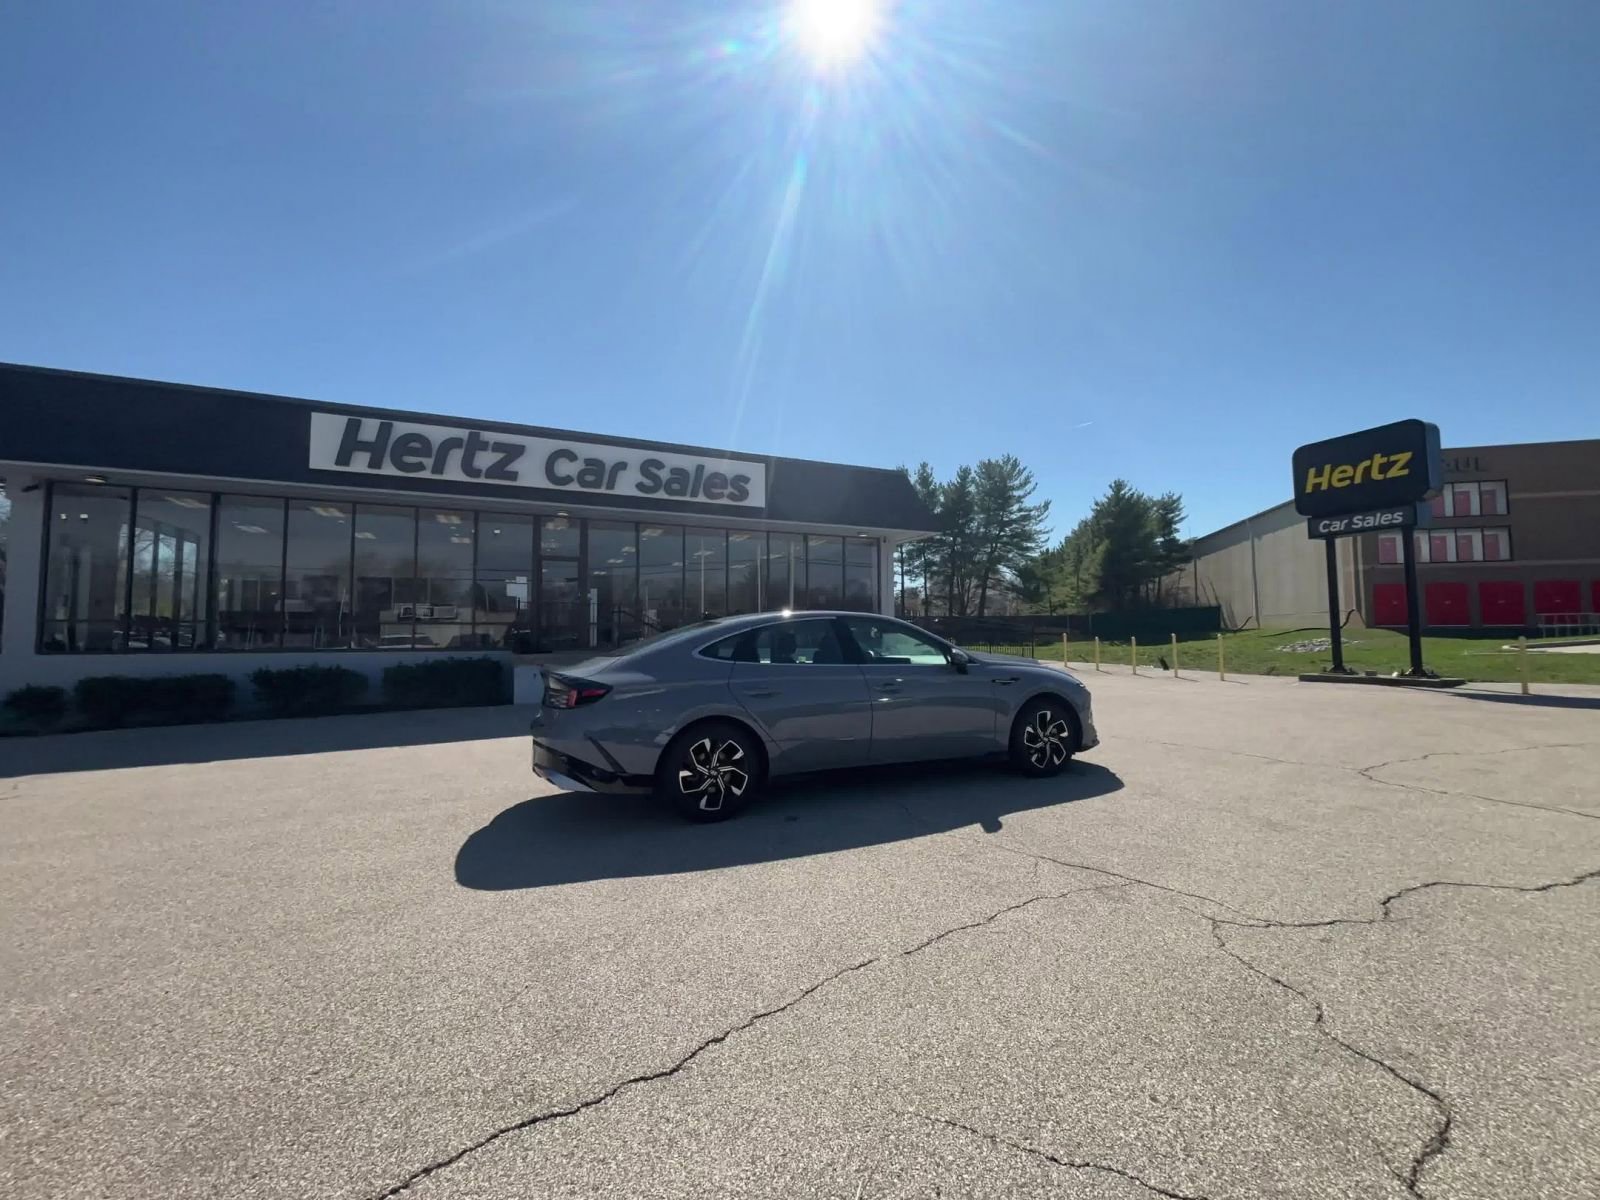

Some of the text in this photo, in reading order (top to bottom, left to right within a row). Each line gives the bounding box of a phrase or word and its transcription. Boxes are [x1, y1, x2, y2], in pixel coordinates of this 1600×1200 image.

[334, 418, 751, 502] Hertz Car Sales
[1305, 452, 1413, 493] Hertz
[1318, 510, 1404, 533] Car Sales
